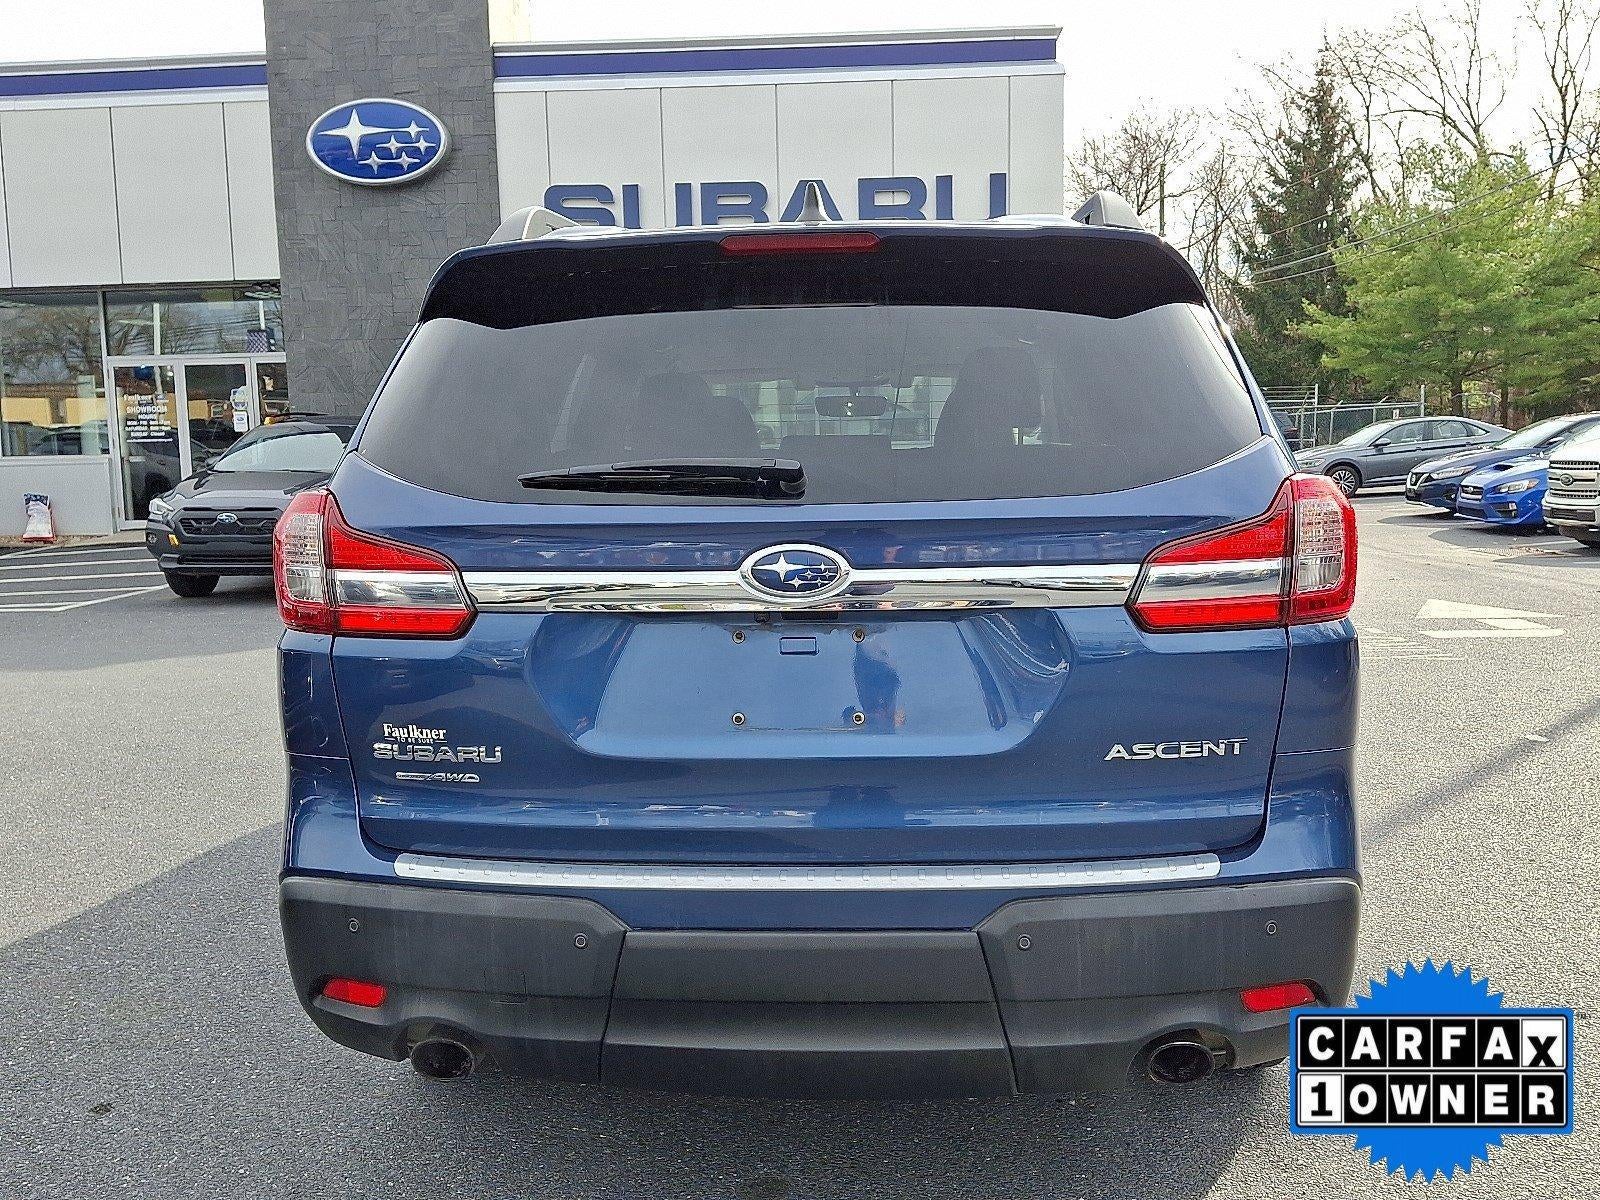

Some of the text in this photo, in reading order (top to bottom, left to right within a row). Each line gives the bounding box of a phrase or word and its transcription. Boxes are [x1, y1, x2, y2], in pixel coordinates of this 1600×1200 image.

[543, 172, 1008, 229] SUBARU
[126, 405, 168, 414] SHOWROOM
[382, 723, 447, 740] Faulkner
[373, 742, 502, 763] SUBARU
[1104, 737, 1249, 761] ASCENT
[426, 772, 480, 782] AWD
